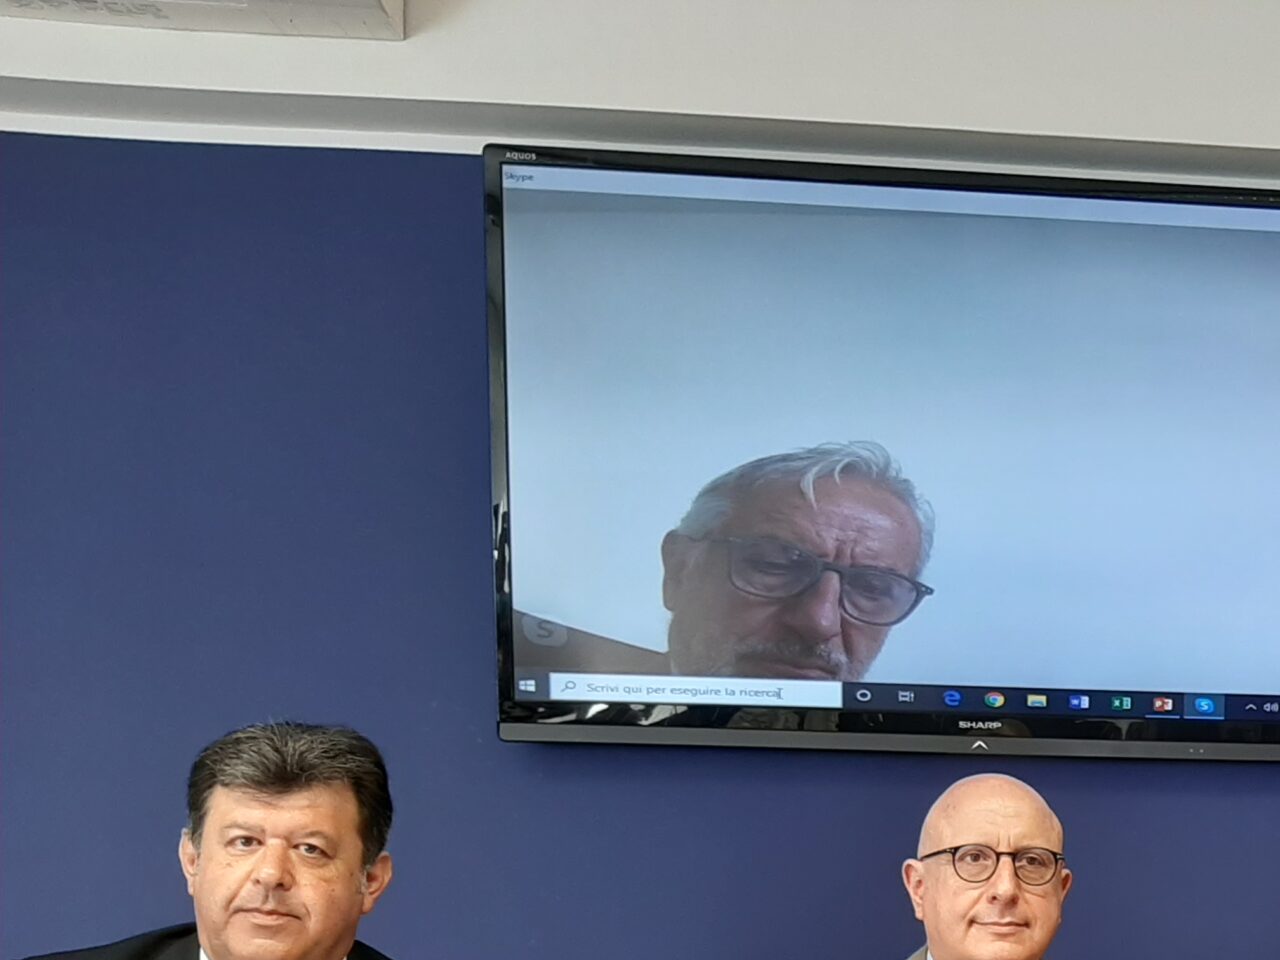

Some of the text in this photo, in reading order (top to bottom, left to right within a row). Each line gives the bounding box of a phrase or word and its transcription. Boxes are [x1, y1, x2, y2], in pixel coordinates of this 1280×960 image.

[505, 151, 537, 161] AQUOS
[504, 172, 534, 182] Skype
[586, 683, 619, 693] Scrivi
[623, 685, 642, 695] qui
[646, 686, 666, 696] per
[670, 685, 721, 697] eseguire
[725, 688, 736, 697] la
[958, 720, 1002, 729] SHARP
